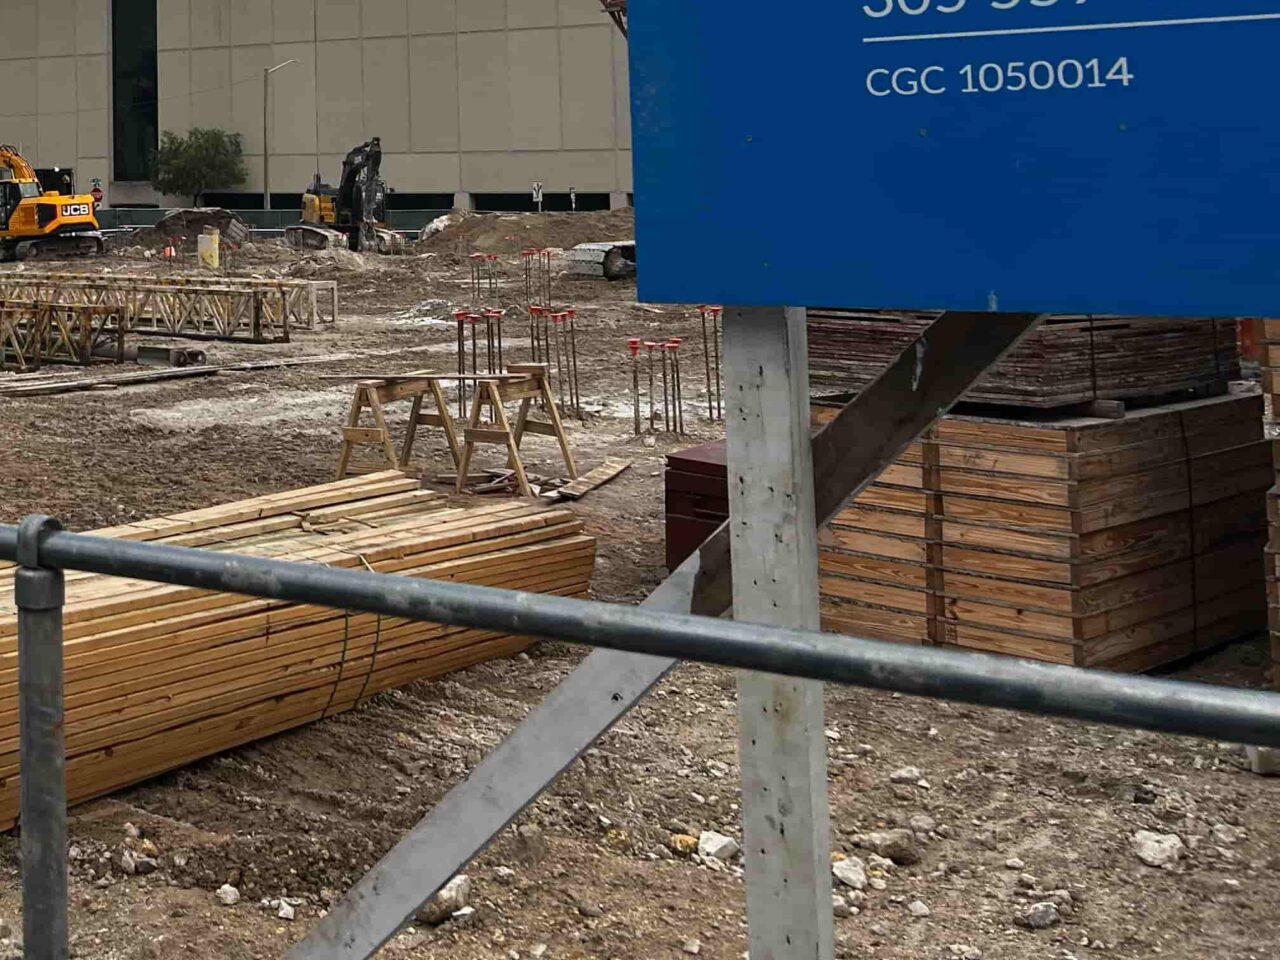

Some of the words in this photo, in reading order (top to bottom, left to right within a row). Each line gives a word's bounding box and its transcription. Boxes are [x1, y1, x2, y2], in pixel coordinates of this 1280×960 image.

[866, 65, 946, 96] CGC
[959, 56, 1134, 93] 1050014
[62, 204, 89, 216] JCB
